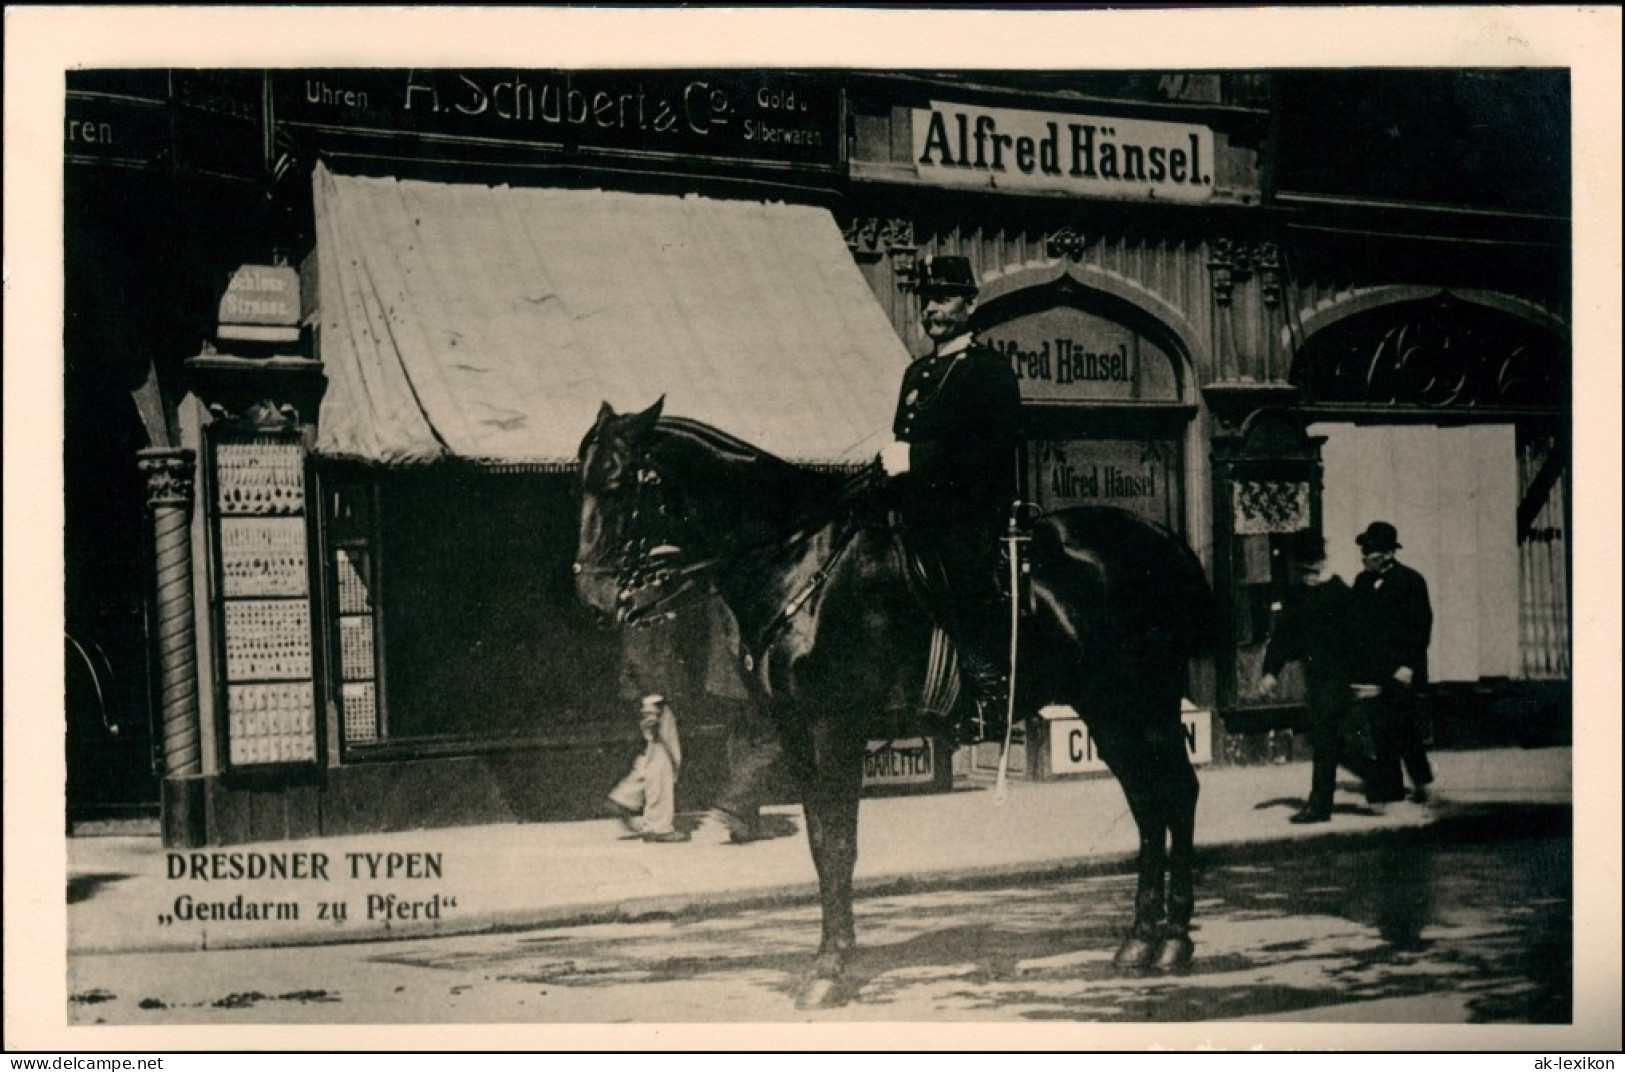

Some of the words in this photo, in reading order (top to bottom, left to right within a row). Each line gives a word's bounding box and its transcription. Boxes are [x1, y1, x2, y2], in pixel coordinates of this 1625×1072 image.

[305, 78, 369, 108] Uhren
[455, 73, 648, 130] Schubert
[651, 101, 680, 133] &
[757, 86, 795, 111] Gold
[743, 119, 823, 146] Silberwaren
[919, 111, 1061, 174] Alfred
[1069, 123, 1211, 184] Hänsel.
[1051, 465, 1098, 498] Alfred
[1104, 465, 1155, 498] Hänsel
